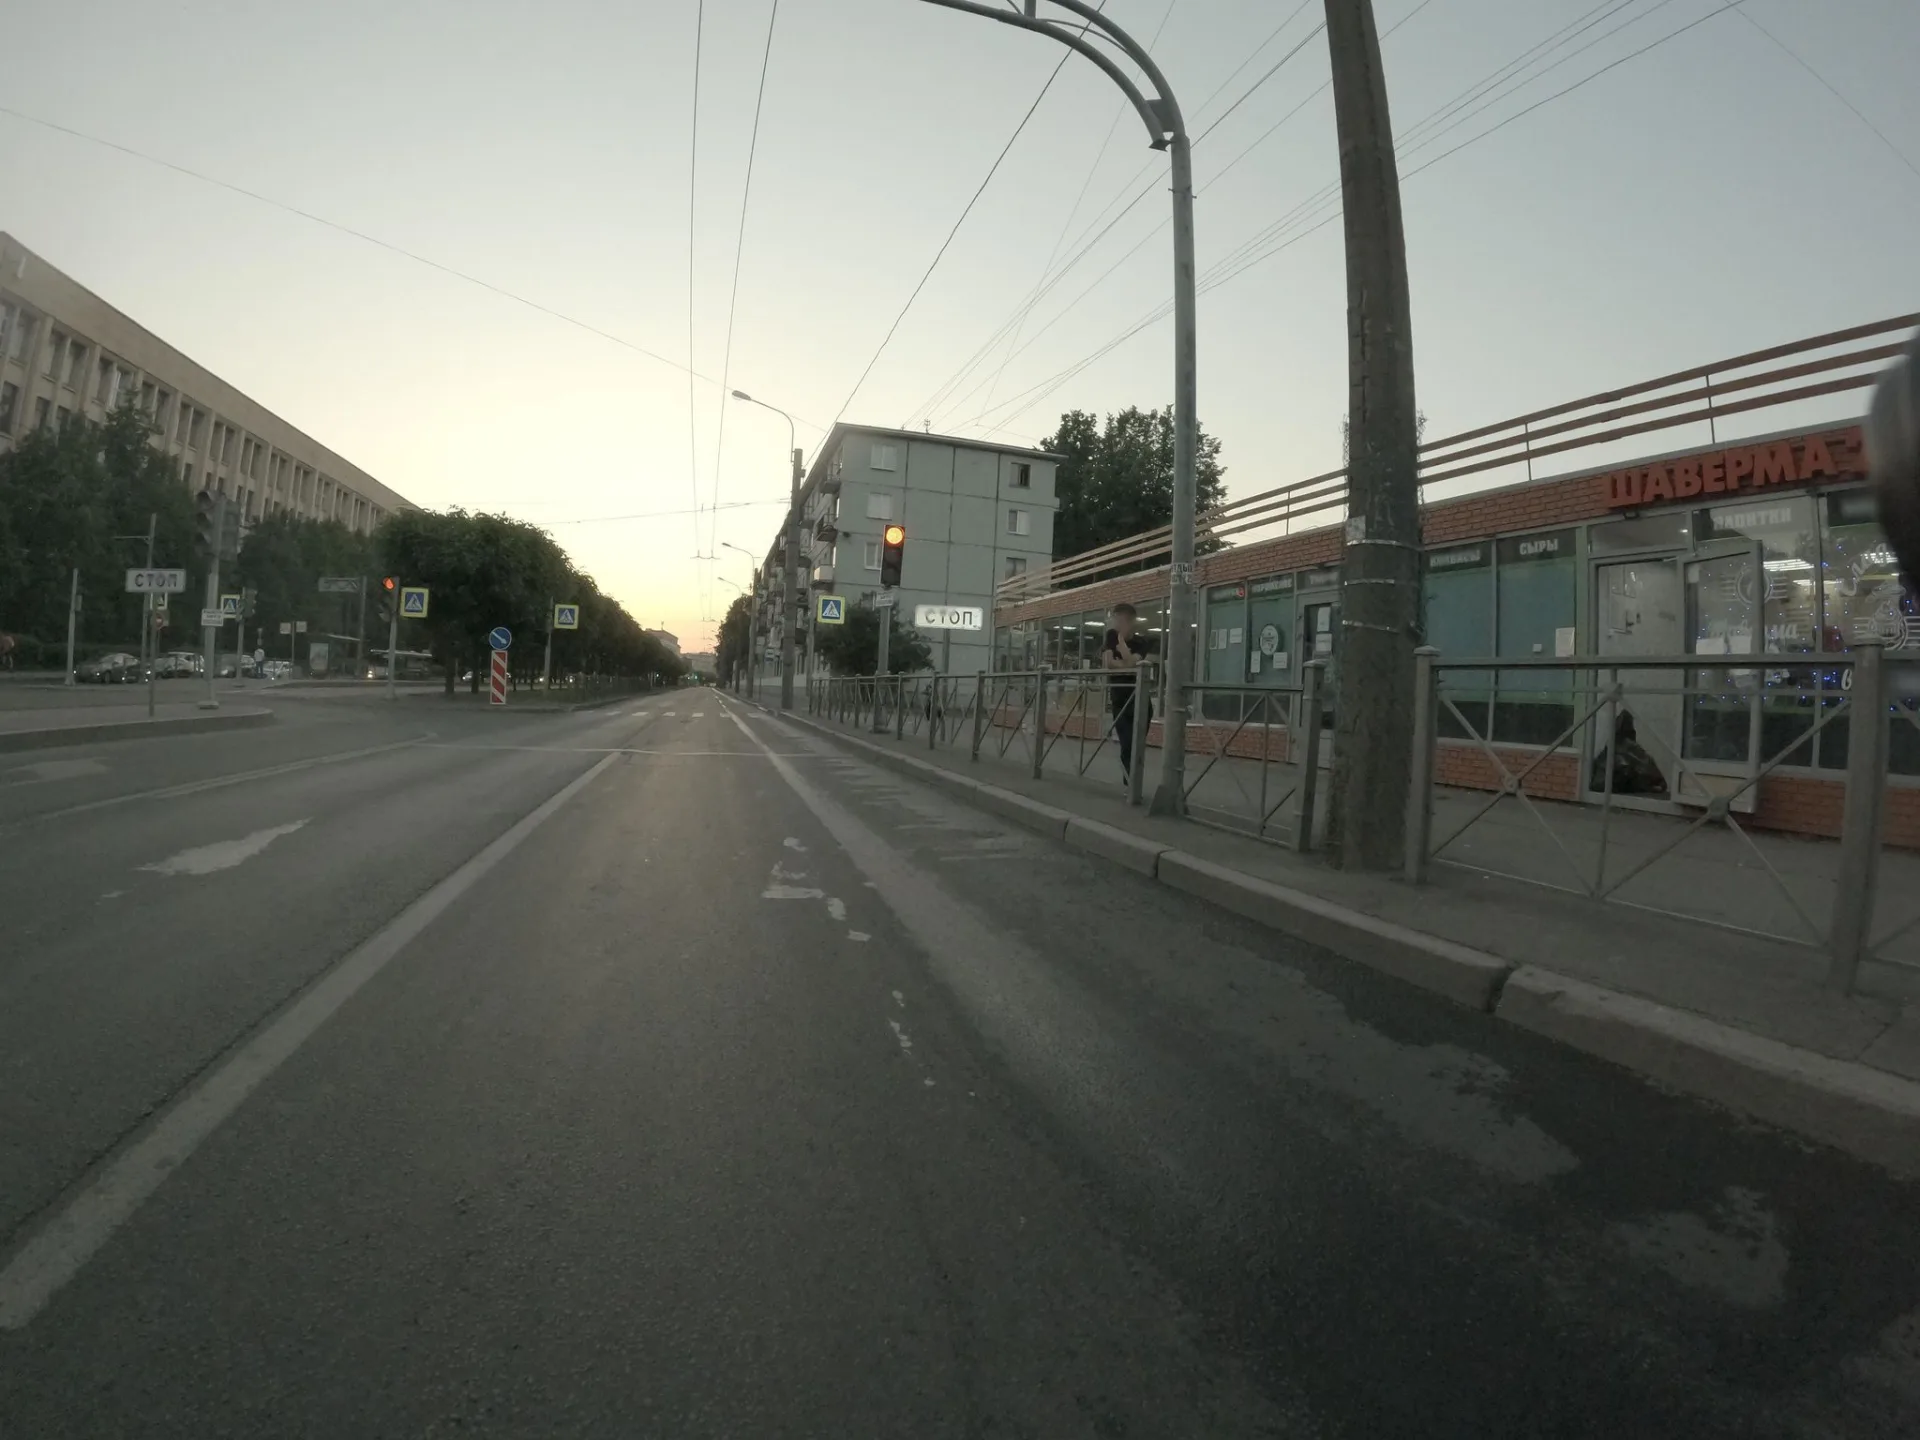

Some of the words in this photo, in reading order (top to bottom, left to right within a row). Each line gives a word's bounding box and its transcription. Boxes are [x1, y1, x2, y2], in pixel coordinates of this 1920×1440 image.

[1607, 435, 1838, 508] ШАВЕРМА
[1519, 538, 1558, 555] СЫРЫ
[134, 572, 178, 588] СТОП
[925, 608, 973, 626] СТОП
